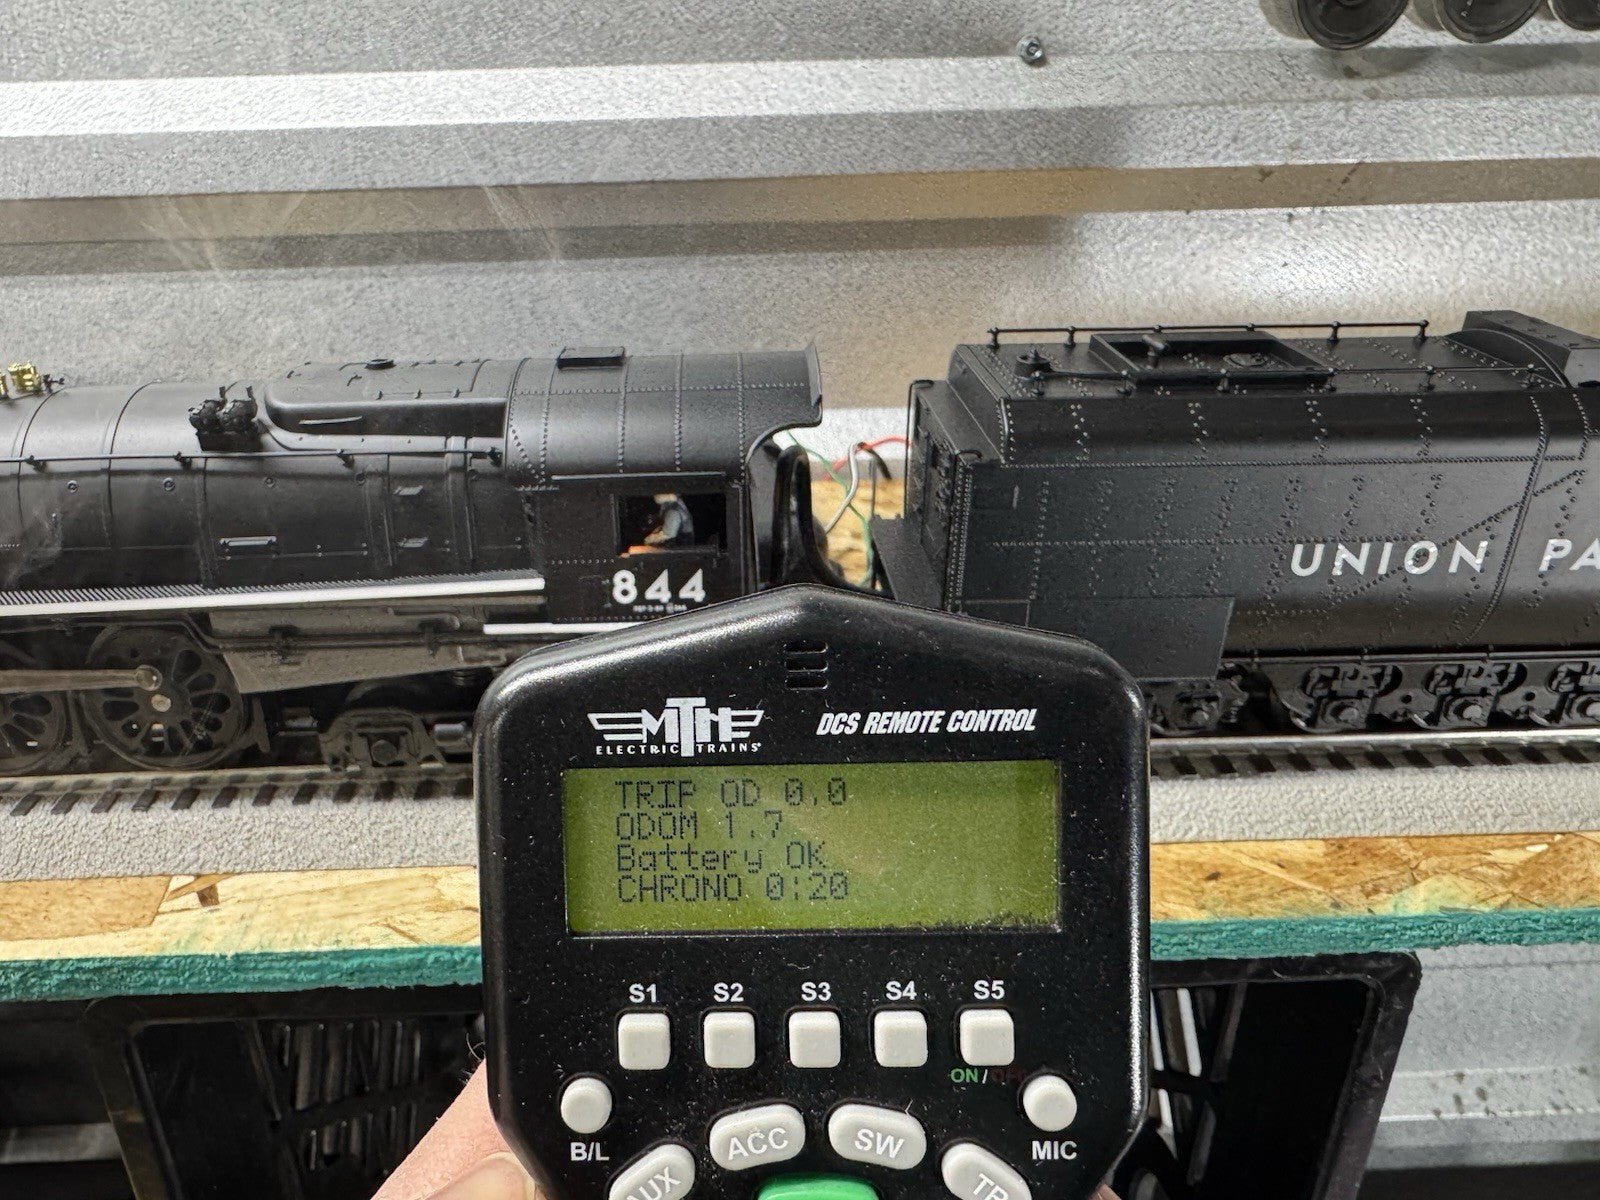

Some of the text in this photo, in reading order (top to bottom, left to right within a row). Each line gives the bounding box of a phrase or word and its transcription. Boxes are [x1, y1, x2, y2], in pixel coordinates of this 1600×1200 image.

[1290, 540, 1489, 577] UNION
[612, 568, 707, 605] 844
[815, 708, 1038, 736] DCS REMOTE CONTROL
[595, 743, 681, 756] ELECTRIC
[615, 779, 698, 809] TRIP
[720, 778, 761, 808] OD
[616, 809, 783, 840] ODOM 1.7
[617, 840, 827, 874] Battery OK
[618, 871, 848, 903] CHRONO 0:20
[628, 983, 659, 1004] S1
[713, 982, 744, 1003] S2
[801, 981, 832, 1002] S3
[885, 980, 918, 1001] S4
[973, 979, 1006, 1000] S5
[570, 1141, 610, 1161] B/L
[727, 1127, 789, 1161] ACC
[854, 1127, 905, 1160] SW
[1031, 1140, 1078, 1160] MIC
